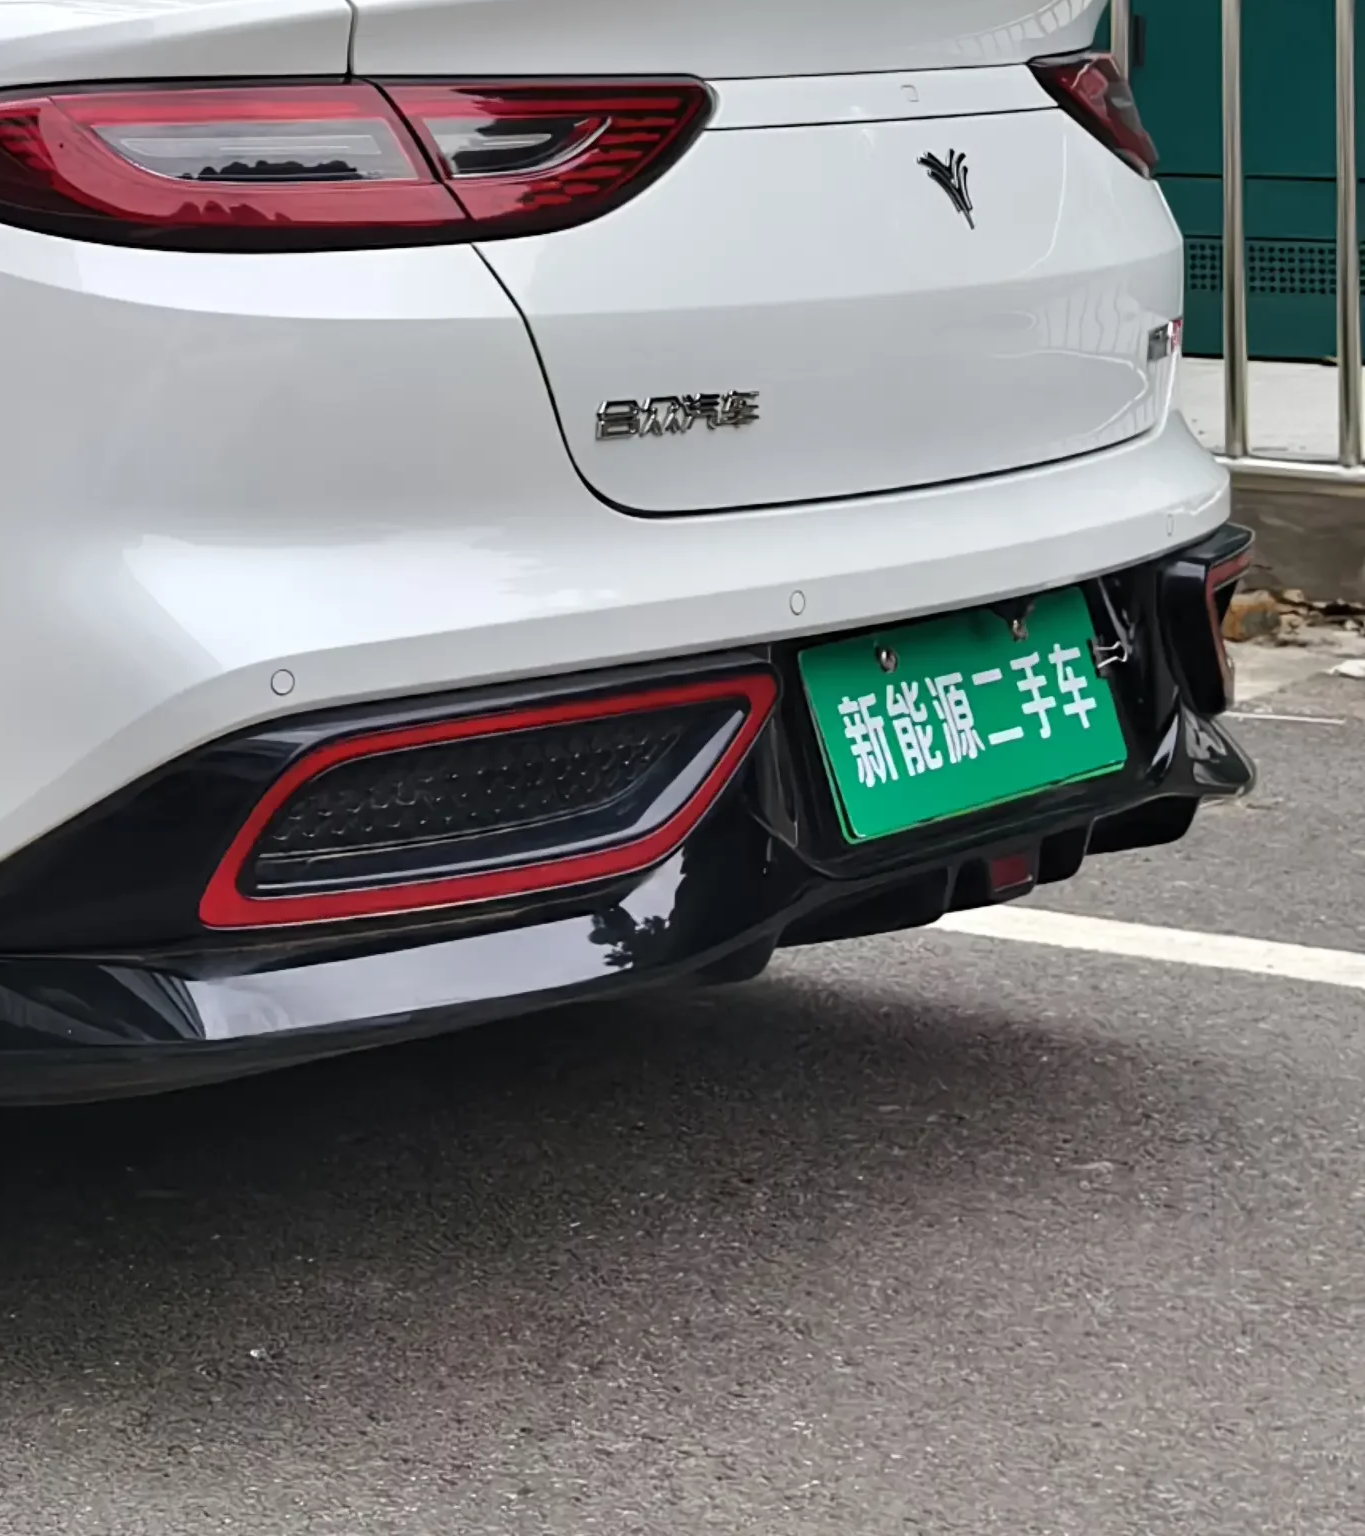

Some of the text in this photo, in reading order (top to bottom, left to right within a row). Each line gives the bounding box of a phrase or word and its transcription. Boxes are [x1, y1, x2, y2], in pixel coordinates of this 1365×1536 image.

[837, 642, 1098, 789] 新能源二手车
